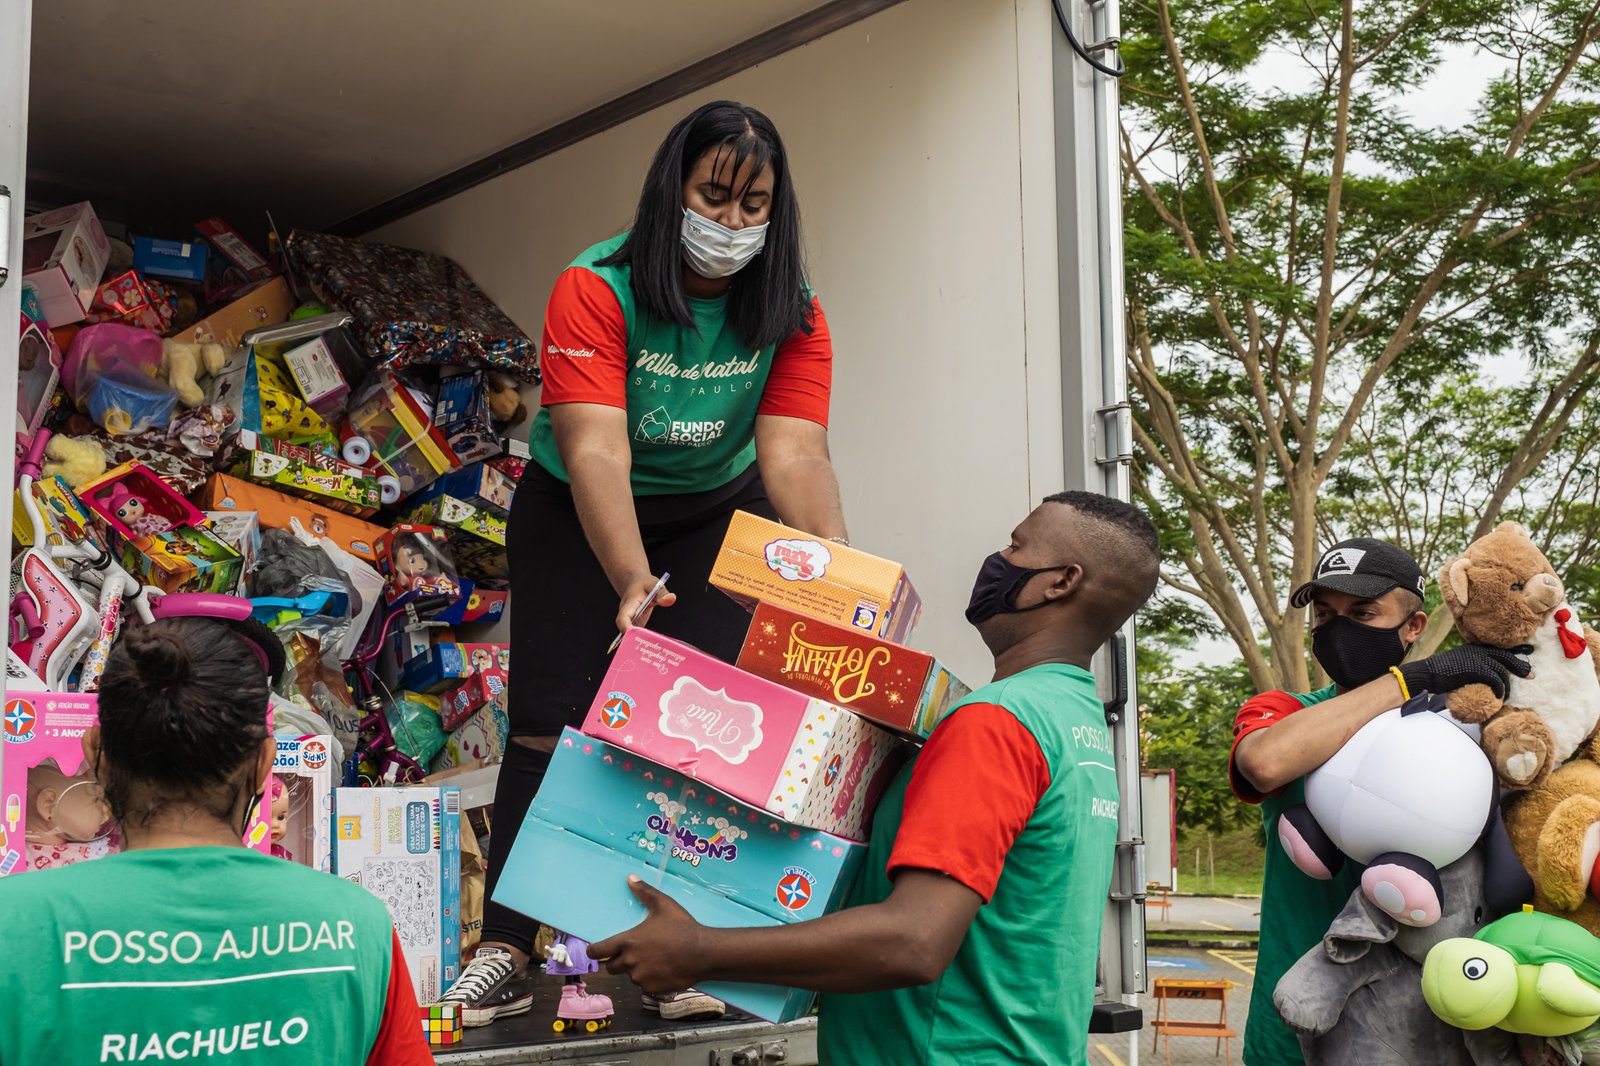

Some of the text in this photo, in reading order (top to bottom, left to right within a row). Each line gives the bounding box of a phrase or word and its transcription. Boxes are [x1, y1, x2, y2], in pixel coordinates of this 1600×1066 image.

[635, 349, 760, 380] Villa de Natal
[635, 377, 753, 396] SÃO PAULO
[671, 420, 725, 433] FUNDO
[669, 430, 723, 443] SOCIAL
[306, 475, 344, 491] Macaco
[774, 545, 814, 564] Azul
[53, 729, 59, 737] 3
[686, 703, 741, 745] Nina
[276, 741, 301, 751] azer
[1071, 725, 1104, 752] POSSO
[1091, 797, 1120, 820] RIACHUEL
[647, 815, 738, 861] ENCNTO
[672, 847, 701, 867] Bebê
[785, 866, 816, 885] ESTRELA
[64, 920, 356, 964] POSSO AJUDAR
[100, 1016, 309, 1063] RIACHUELO
